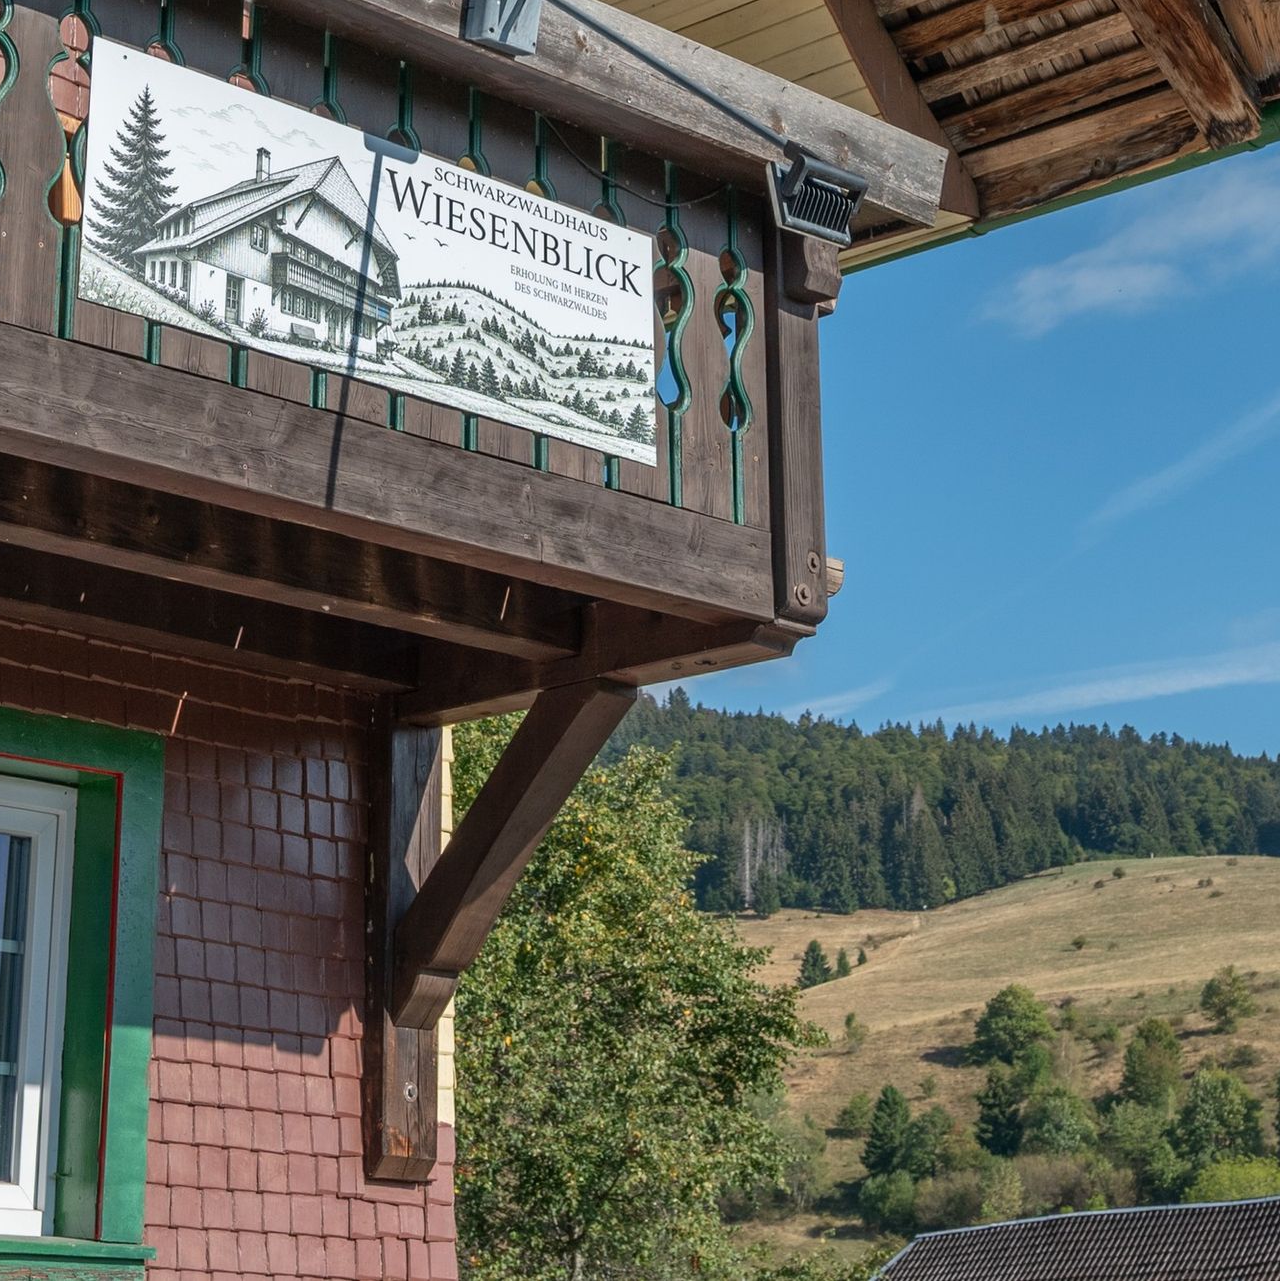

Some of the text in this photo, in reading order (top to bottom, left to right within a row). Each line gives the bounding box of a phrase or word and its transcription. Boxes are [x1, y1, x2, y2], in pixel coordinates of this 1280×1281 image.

[385, 168, 643, 297] WIESENBLICK
[434, 167, 608, 241] SCHWARZWALDHAUS
[510, 265, 608, 306] ERHOLUNG IM HERZEN
[514, 281, 608, 320] DES SCHWARZWALDES
